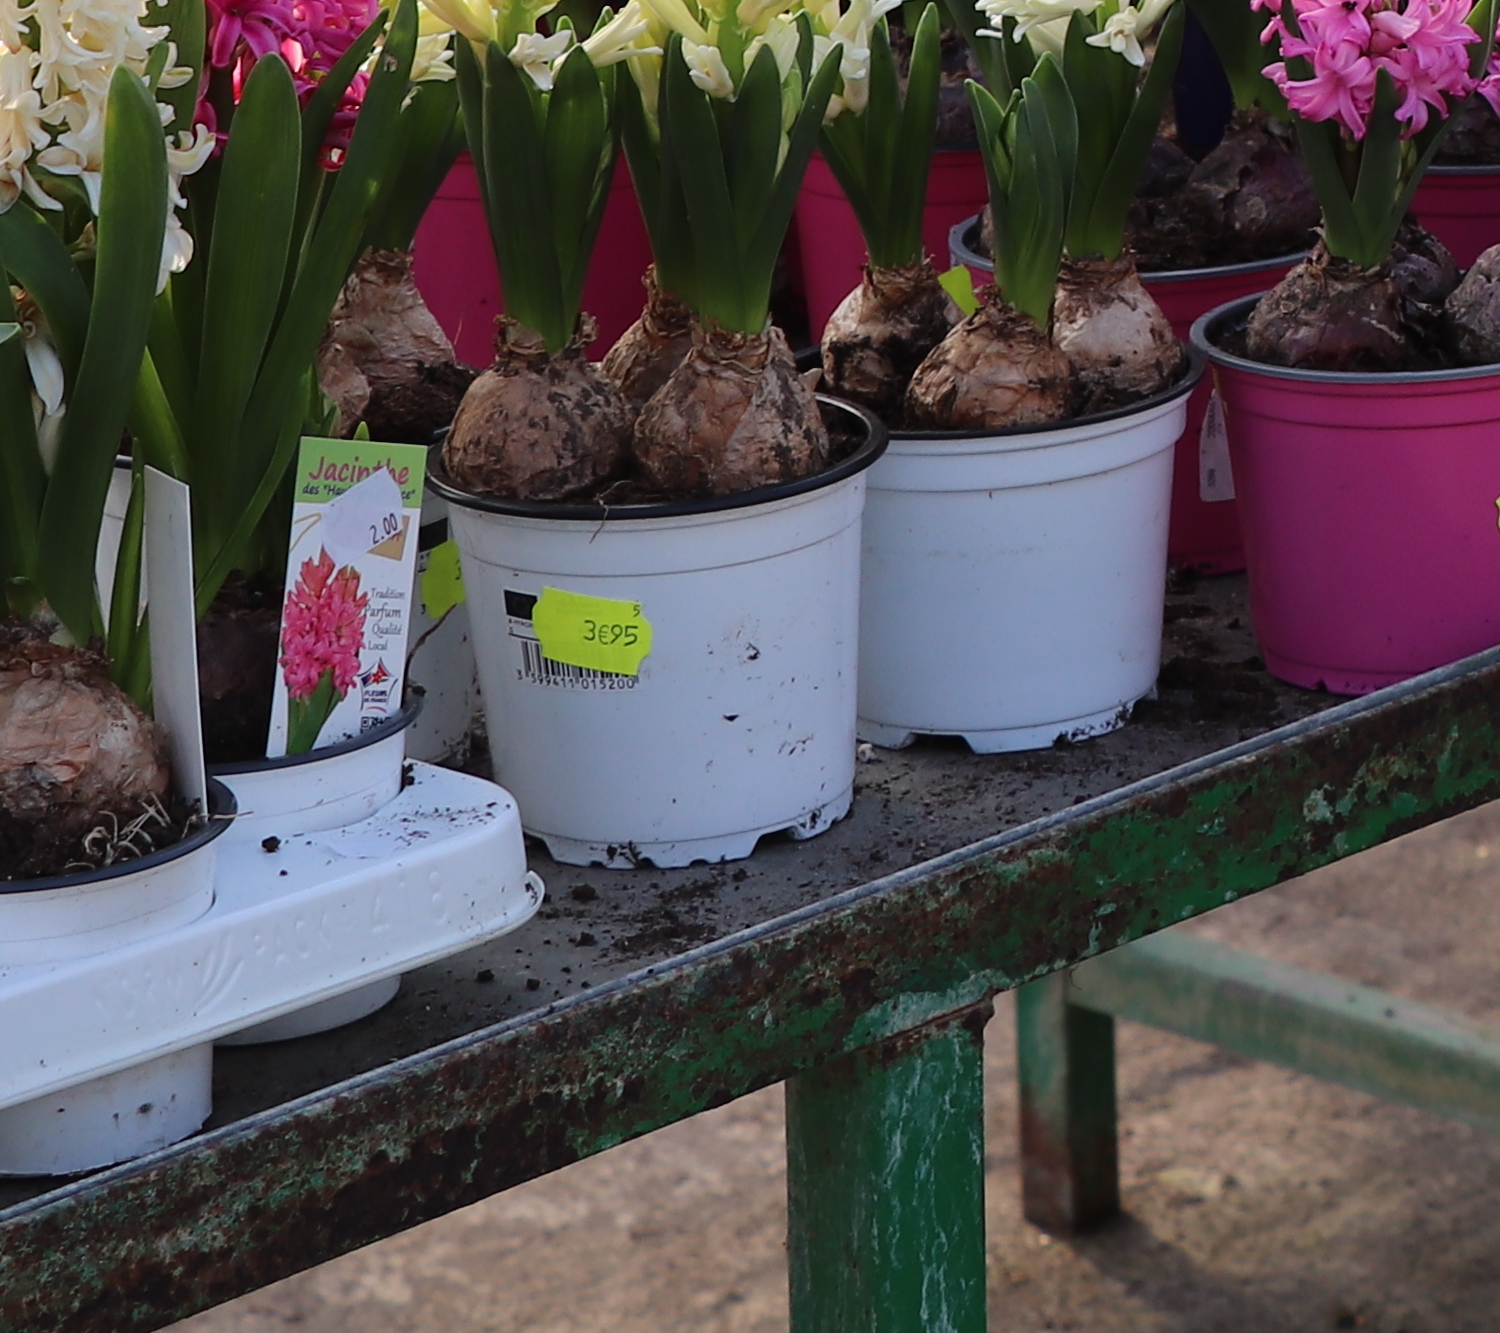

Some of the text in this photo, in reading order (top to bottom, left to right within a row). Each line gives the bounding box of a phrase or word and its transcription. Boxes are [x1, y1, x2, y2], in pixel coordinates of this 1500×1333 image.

[302, 482, 320, 495] des
[368, 512, 399, 545] 2.00
[583, 619, 639, 647] 3€95
